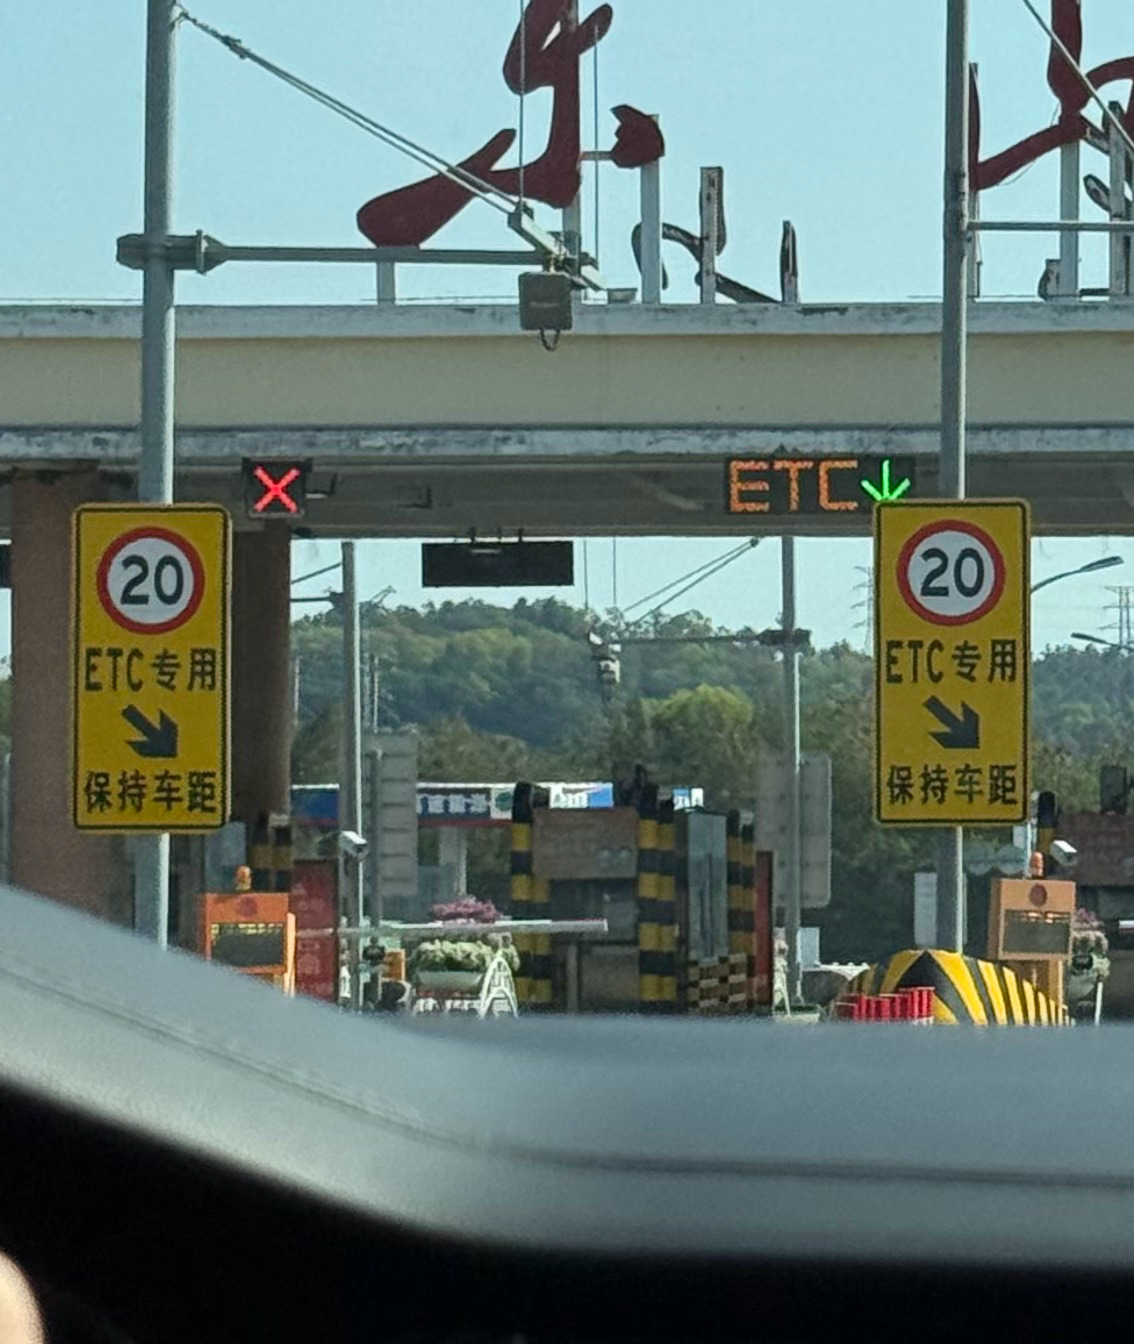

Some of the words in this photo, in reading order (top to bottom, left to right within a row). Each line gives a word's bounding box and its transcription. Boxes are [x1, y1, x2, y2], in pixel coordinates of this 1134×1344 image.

[731, 460, 858, 511] ETC
[120, 554, 184, 606] 20
[920, 547, 985, 598] 20
[84, 647, 217, 693] ETC专用
[885, 639, 1017, 684] ETC专用
[84, 769, 217, 814] 保持车距
[886, 763, 1018, 806] 保持车距
